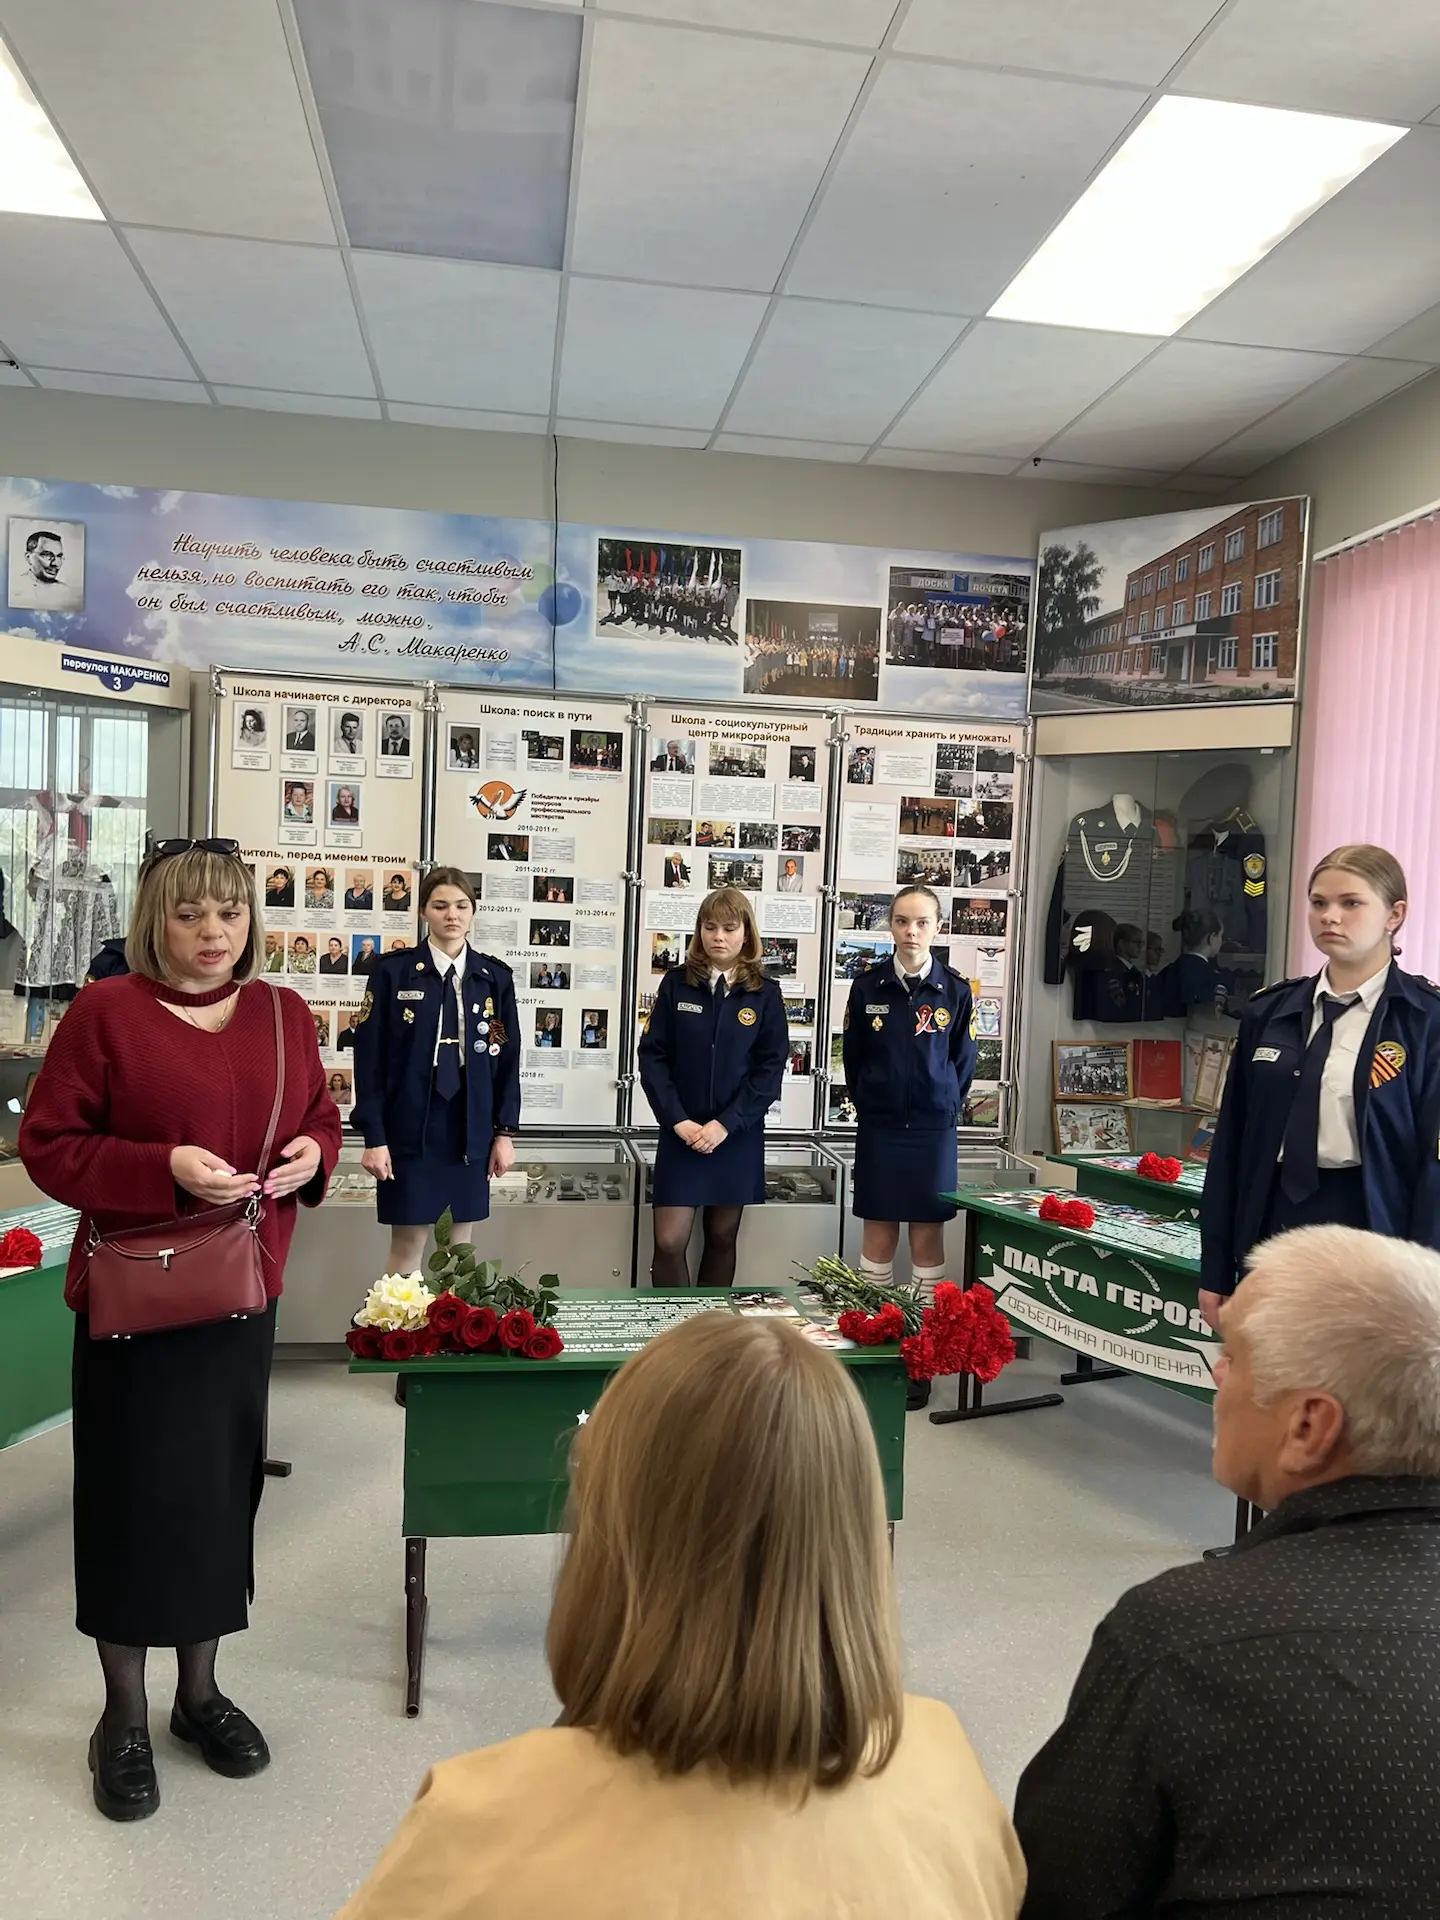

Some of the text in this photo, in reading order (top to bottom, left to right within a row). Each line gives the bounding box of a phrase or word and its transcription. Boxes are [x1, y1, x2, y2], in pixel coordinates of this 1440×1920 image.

[172, 533, 533, 578] Научить человека быть счастливым
[137, 567, 507, 604] нельзя, но воспитать его так, чтобы
[137, 595, 161, 608] он
[170, 594, 207, 611] был
[215, 601, 343, 623] счастливым,
[398, 637, 510, 663] Макаренко
[63, 658, 169, 683] переулок МАКАРЕНКО
[113, 677, 122, 690] 3
[233, 686, 412, 707] Школа начинается с директора
[480, 704, 593, 722] Школа: поиск в пути
[671, 715, 706, 725] Школа
[715, 718, 808, 732] социокультурный
[688, 729, 791, 743] центр микрорайона
[854, 725, 1012, 744] Традиции хранить и умножать!
[531, 792, 567, 800] Победители
[531, 807, 591, 815] профессионального
[517, 824, 551, 833] 2010-2011
[240, 849, 407, 864] читель, перед именем твоим
[515, 865, 549, 873] 2011-2012
[479, 904, 513, 913] 2012-2013
[575, 909, 609, 917] 2013-2014
[506, 949, 539, 957] 2014-2015
[339, 1000, 363, 1008] наш
[1003, 1245, 1213, 1338] ПАРТА ГЕРОЯ
[1008, 1296, 1202, 1379] ОБЪЕДИНЯЯ ПОКОЛЕНИЯ
